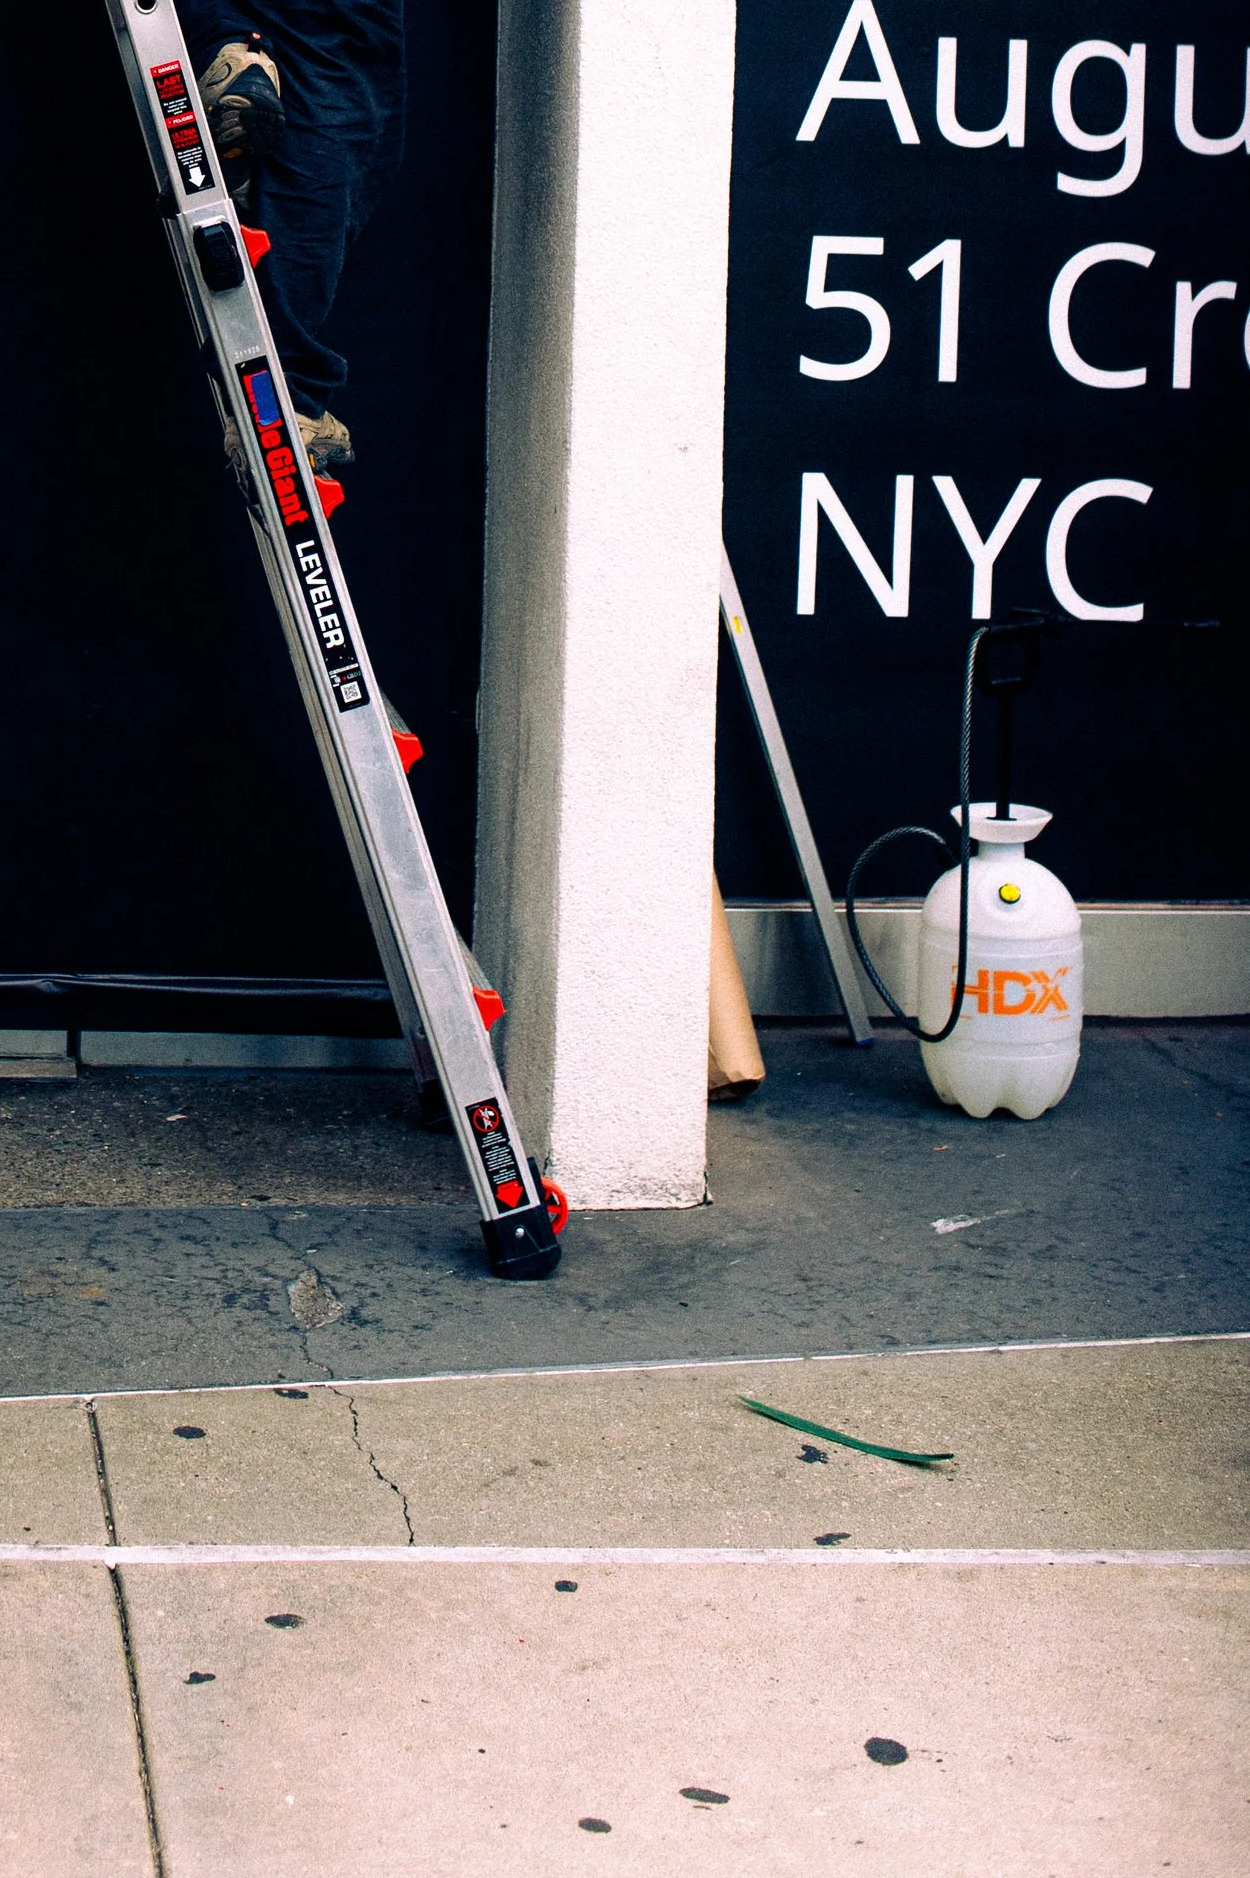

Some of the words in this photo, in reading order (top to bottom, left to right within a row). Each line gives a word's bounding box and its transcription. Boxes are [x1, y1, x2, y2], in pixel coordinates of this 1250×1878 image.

[799, 234, 962, 382] 51
[1048, 241, 1250, 389] Cr
[266, 445, 310, 527] Giant
[295, 539, 345, 649] LEVELER
[795, 472, 1154, 622] NYC
[950, 965, 1073, 1016] HDX
